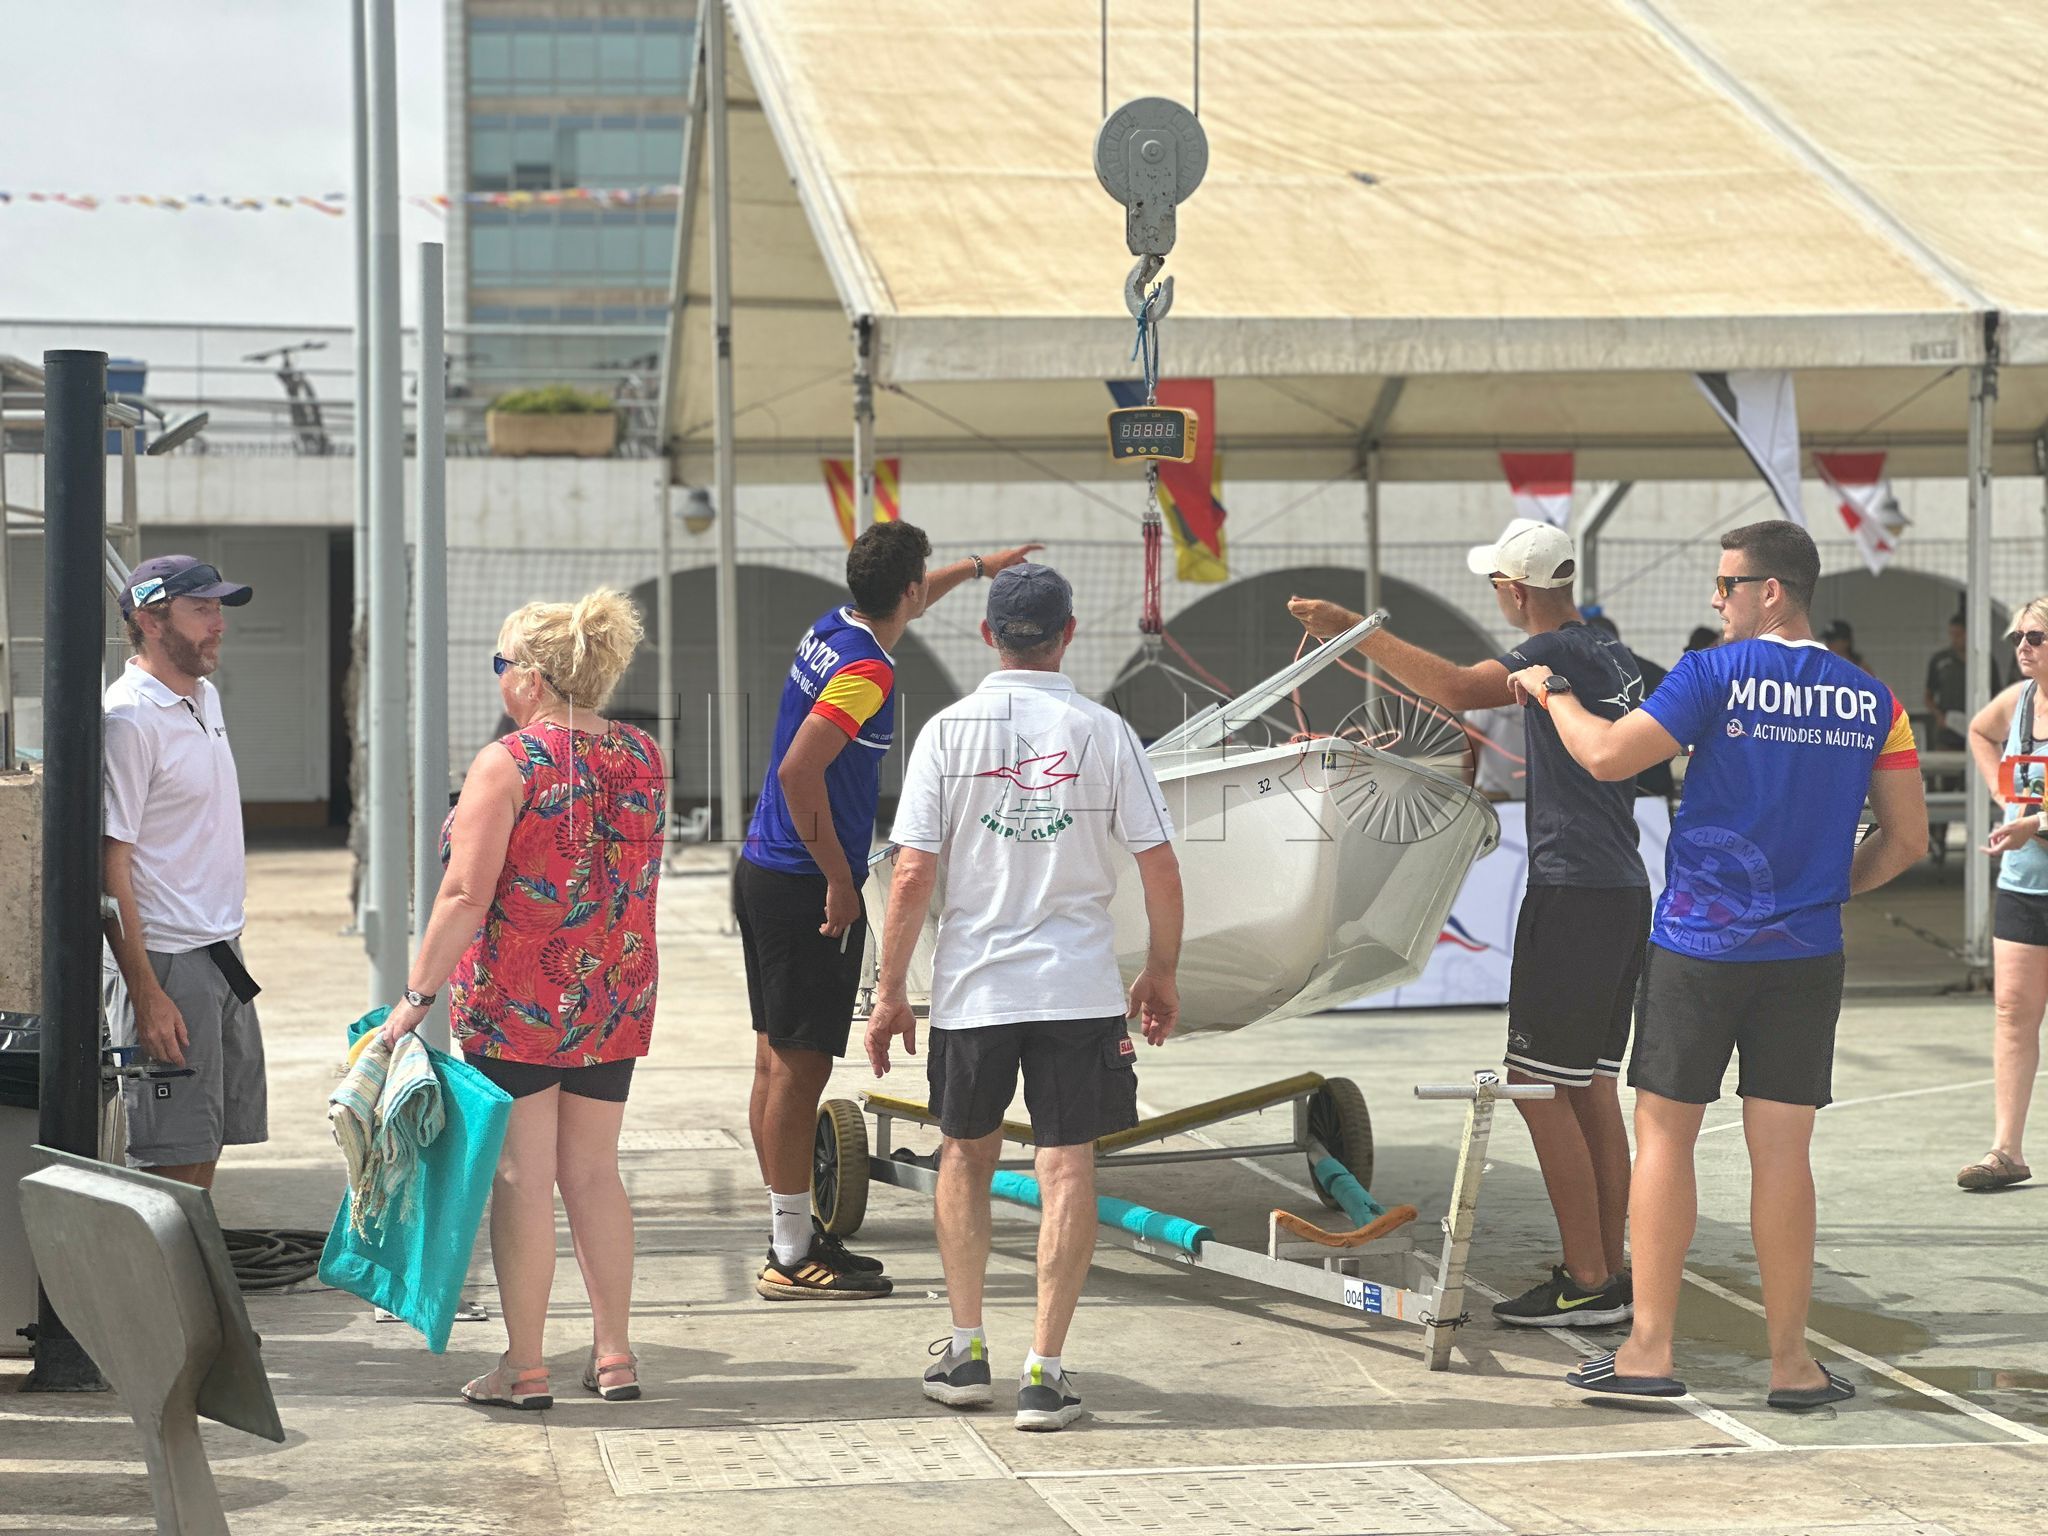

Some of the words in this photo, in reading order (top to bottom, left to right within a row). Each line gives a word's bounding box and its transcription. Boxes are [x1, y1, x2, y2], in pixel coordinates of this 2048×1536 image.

[1727, 677, 1877, 724] MONITOR
[1257, 778, 1272, 794] 32
[1031, 814, 1073, 840] CLASS
[1694, 831, 1736, 849] CLUB
[1345, 1289, 1362, 1306] 004
